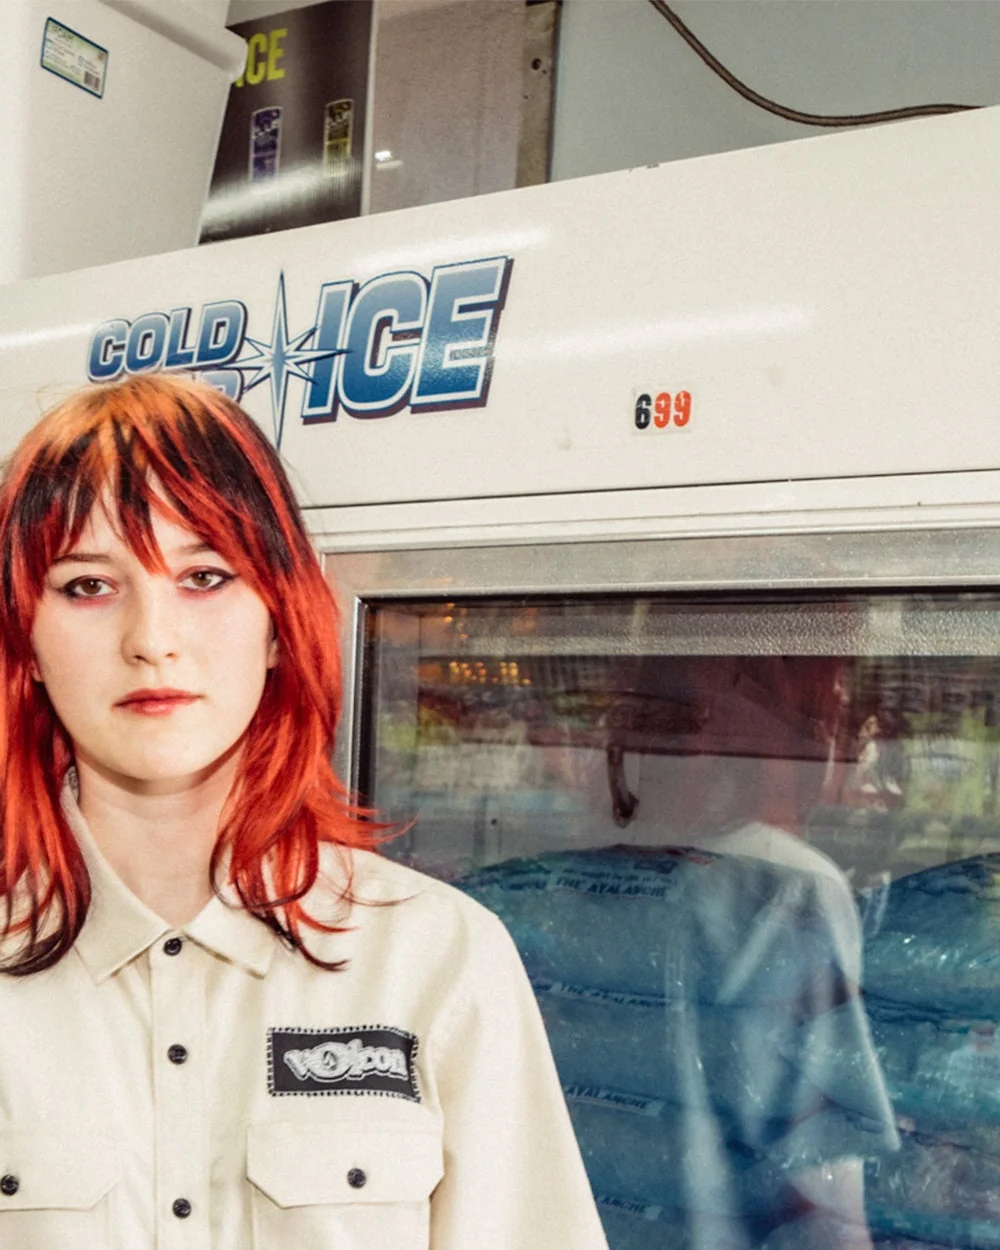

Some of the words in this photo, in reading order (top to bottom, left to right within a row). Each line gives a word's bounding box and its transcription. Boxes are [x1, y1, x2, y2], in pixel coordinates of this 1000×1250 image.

[236, 28, 288, 88] CE
[88, 300, 248, 383] COLD
[300, 256, 515, 425] ICE
[635, 390, 691, 430] 699
